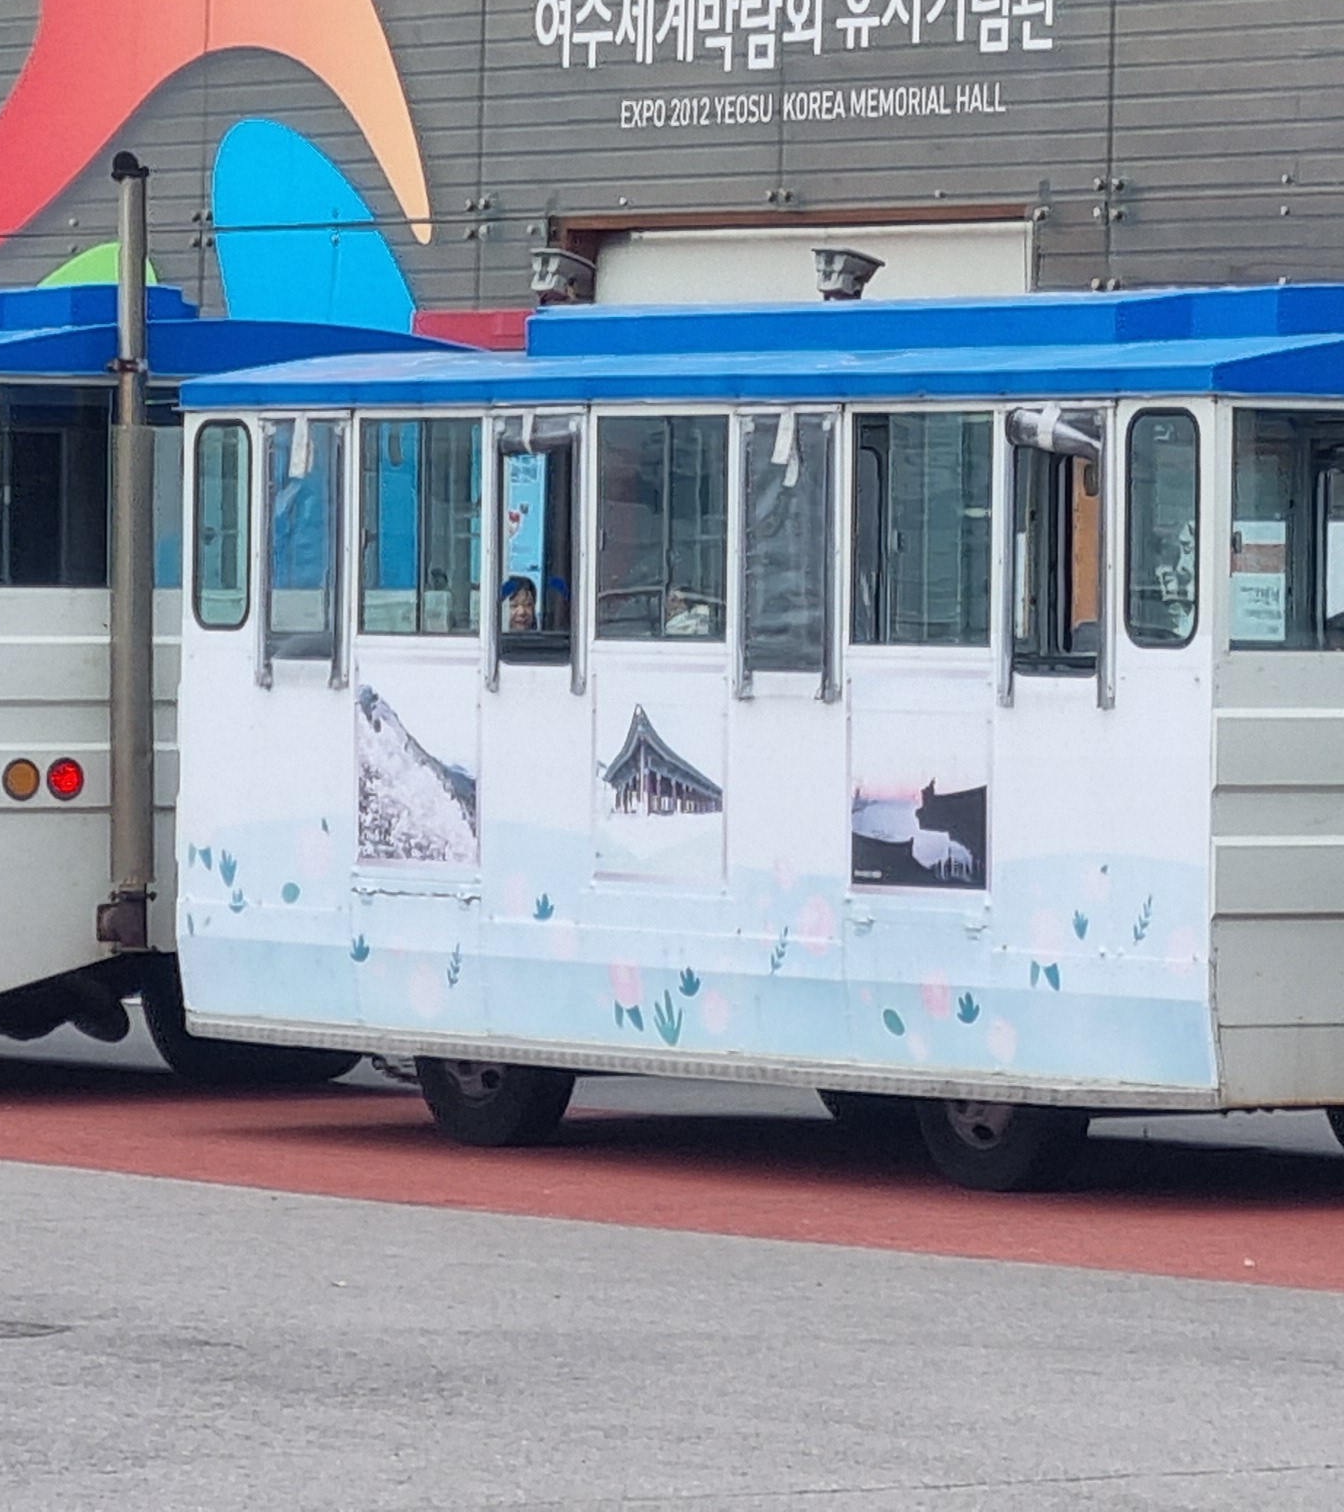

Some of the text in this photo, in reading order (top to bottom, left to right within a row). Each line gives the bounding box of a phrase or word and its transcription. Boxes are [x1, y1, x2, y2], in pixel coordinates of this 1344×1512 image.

[620, 82, 1006, 129] EXPO 2012 YEOSU KOREA MEMORIAL HALL
